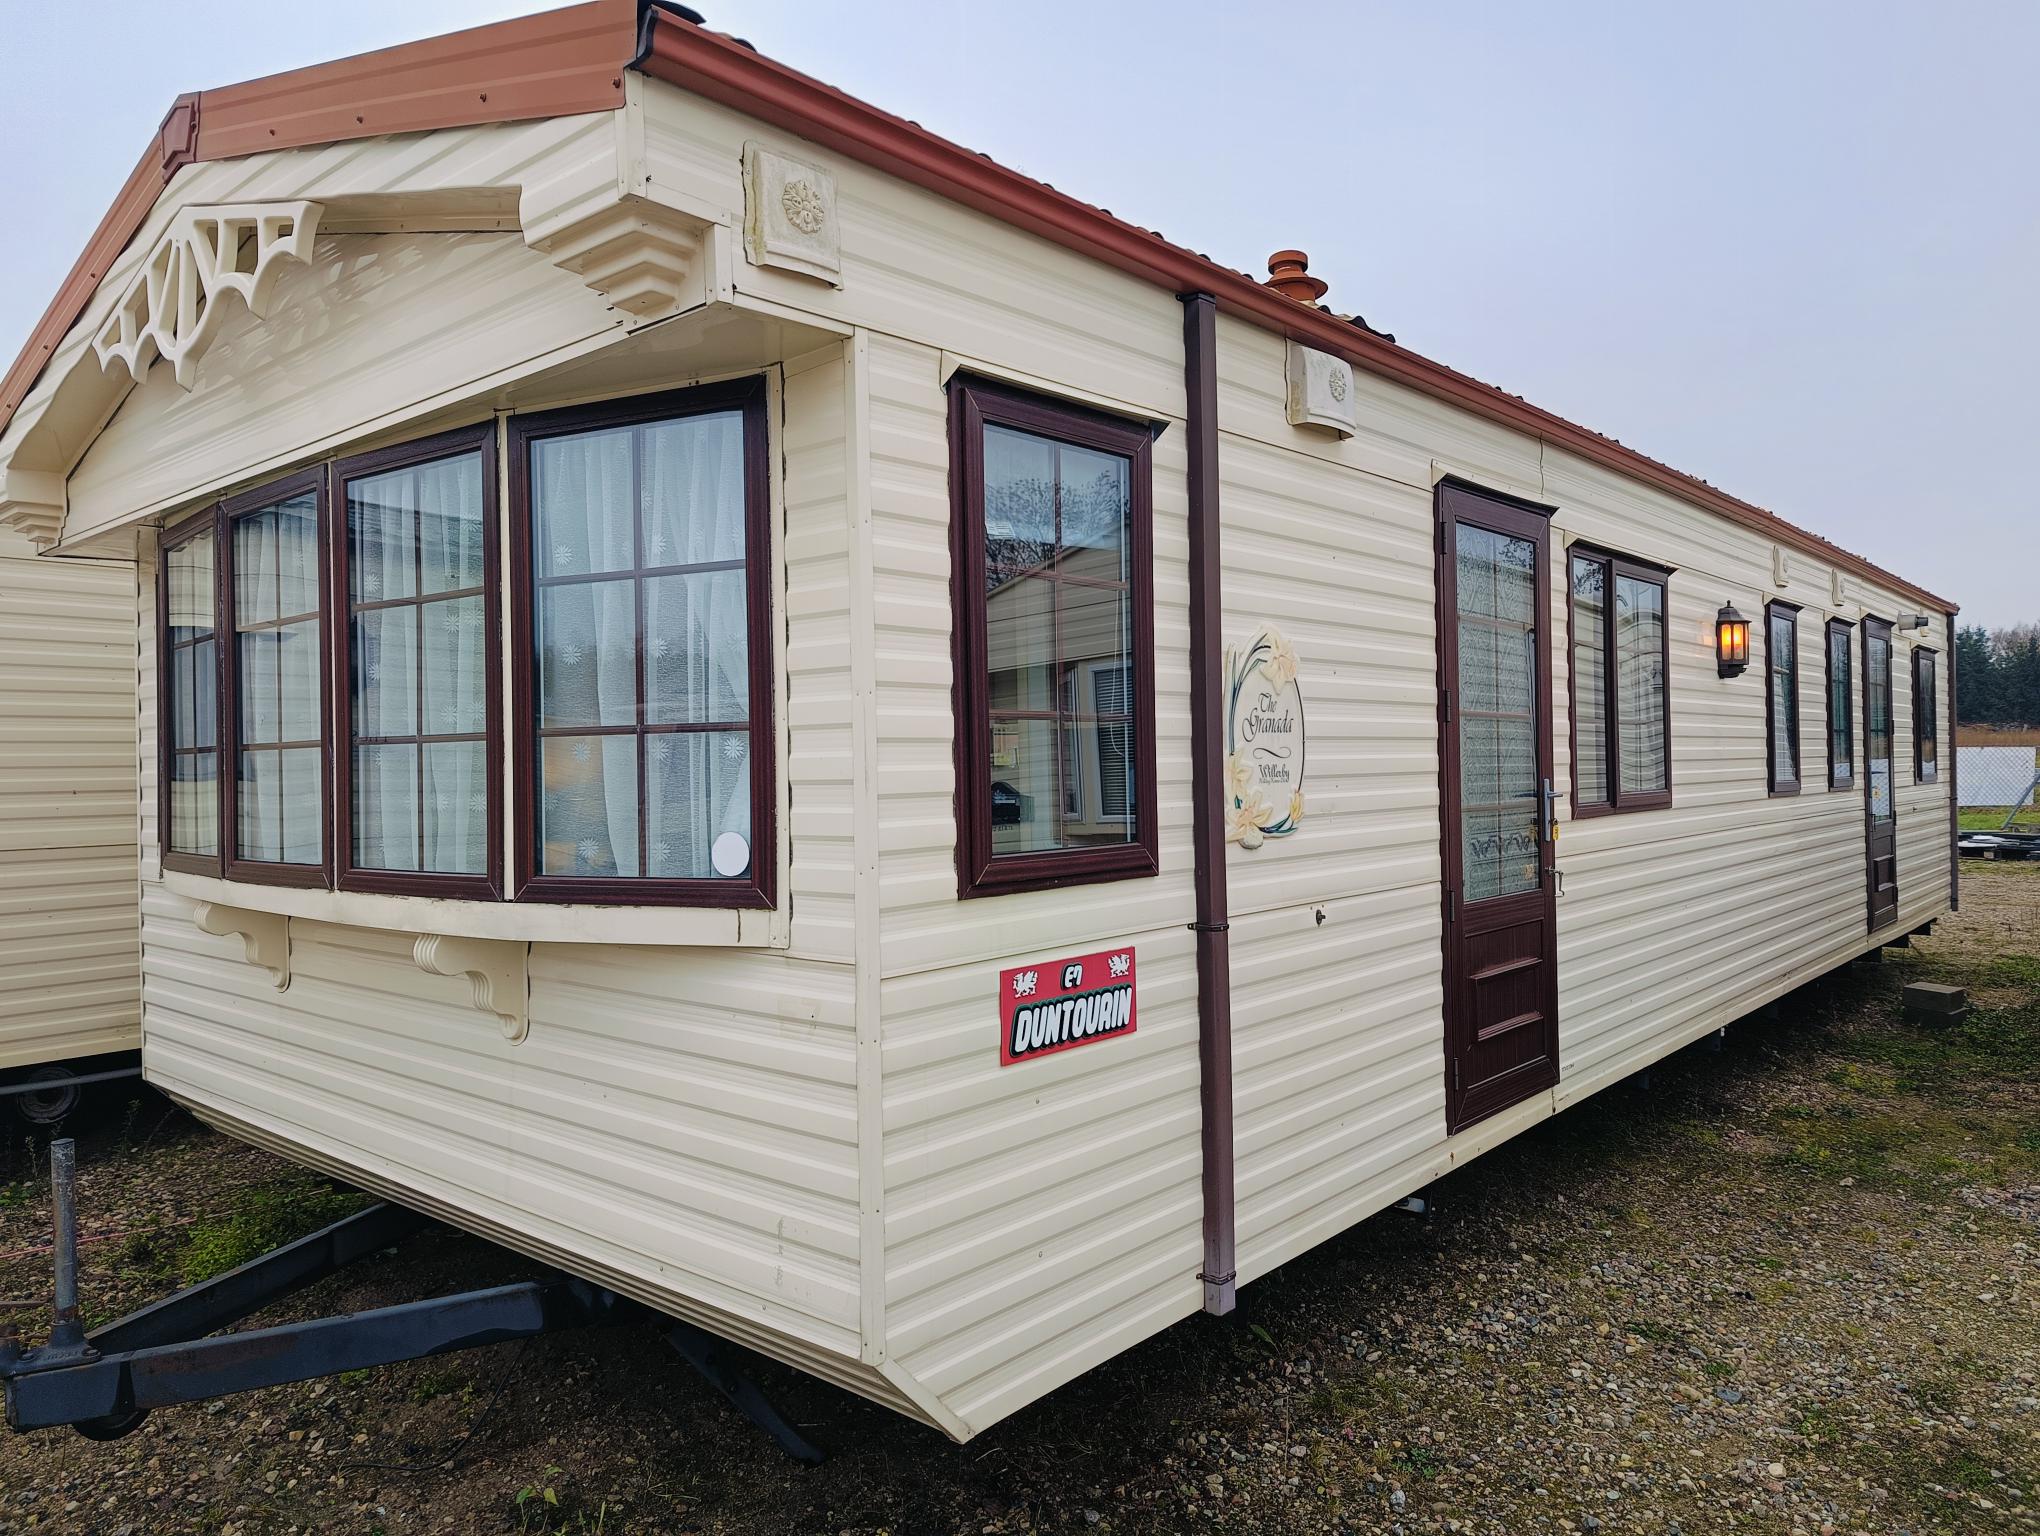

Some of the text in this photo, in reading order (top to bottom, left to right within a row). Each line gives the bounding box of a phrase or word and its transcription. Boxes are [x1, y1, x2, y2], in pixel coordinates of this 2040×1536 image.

[1258, 692, 1278, 713] The
[1241, 707, 1294, 743] Granada
[1258, 763, 1290, 782] Willerby
[1013, 985, 1133, 1054] DUNTOURIN
